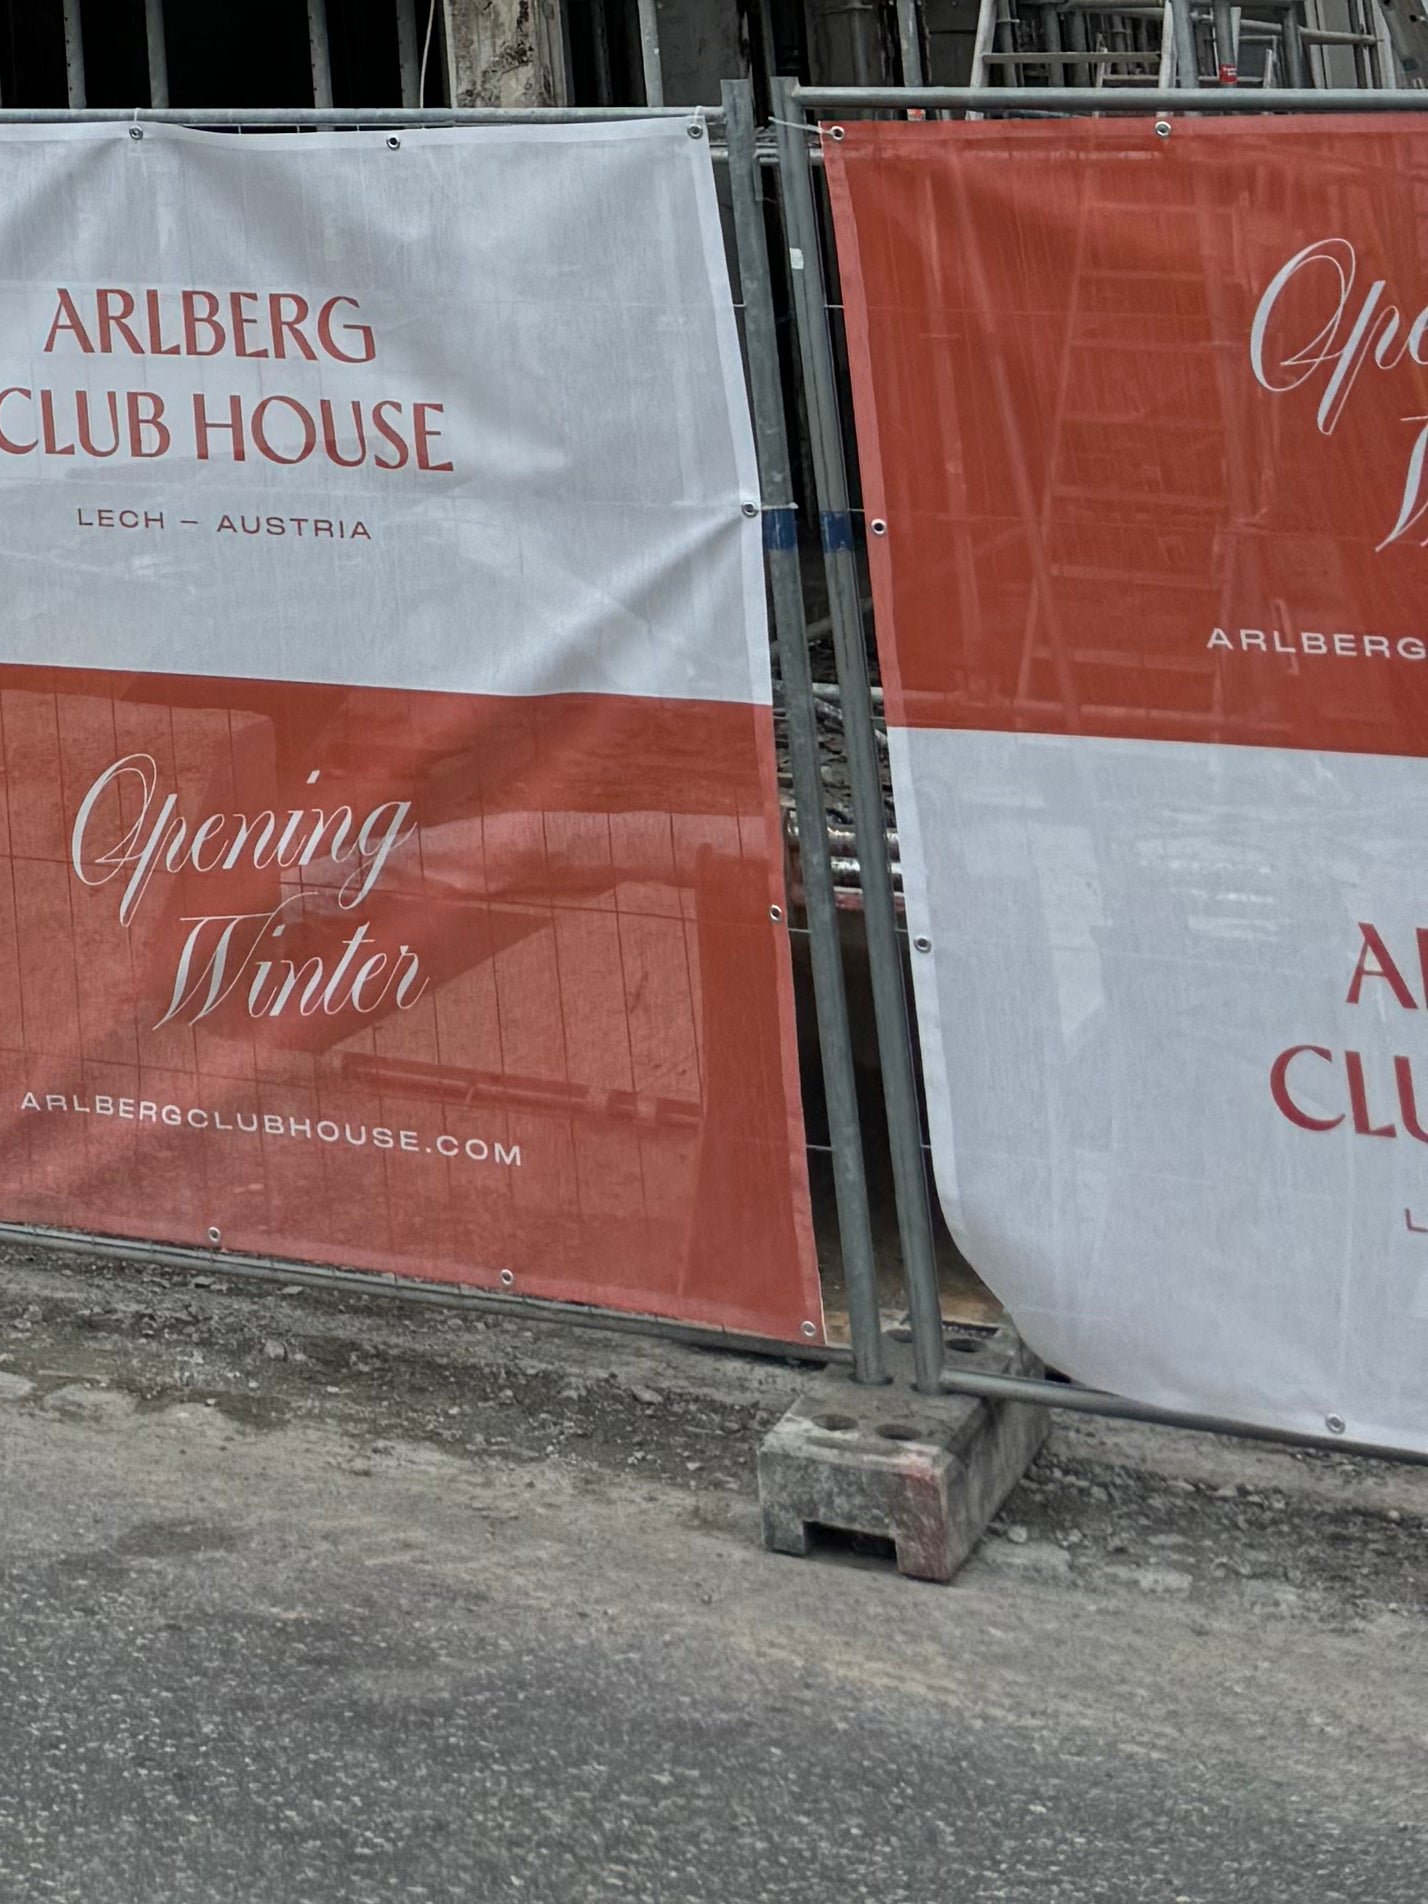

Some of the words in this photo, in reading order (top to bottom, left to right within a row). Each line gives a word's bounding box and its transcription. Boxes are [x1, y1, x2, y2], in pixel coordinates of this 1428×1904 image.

[44, 288, 376, 363] ARLBERG
[193, 393, 454, 472] HOUSE
[77, 508, 165, 530] LECH
[216, 514, 372, 540] AUSTRIA
[1206, 628, 1427, 660] ARLBERG
[72, 753, 417, 927] Opening
[153, 892, 429, 1030] Winter
[1345, 921, 1428, 1010] A
[21, 1091, 523, 1166] ARLBERGCLUBHOUSE.COM
